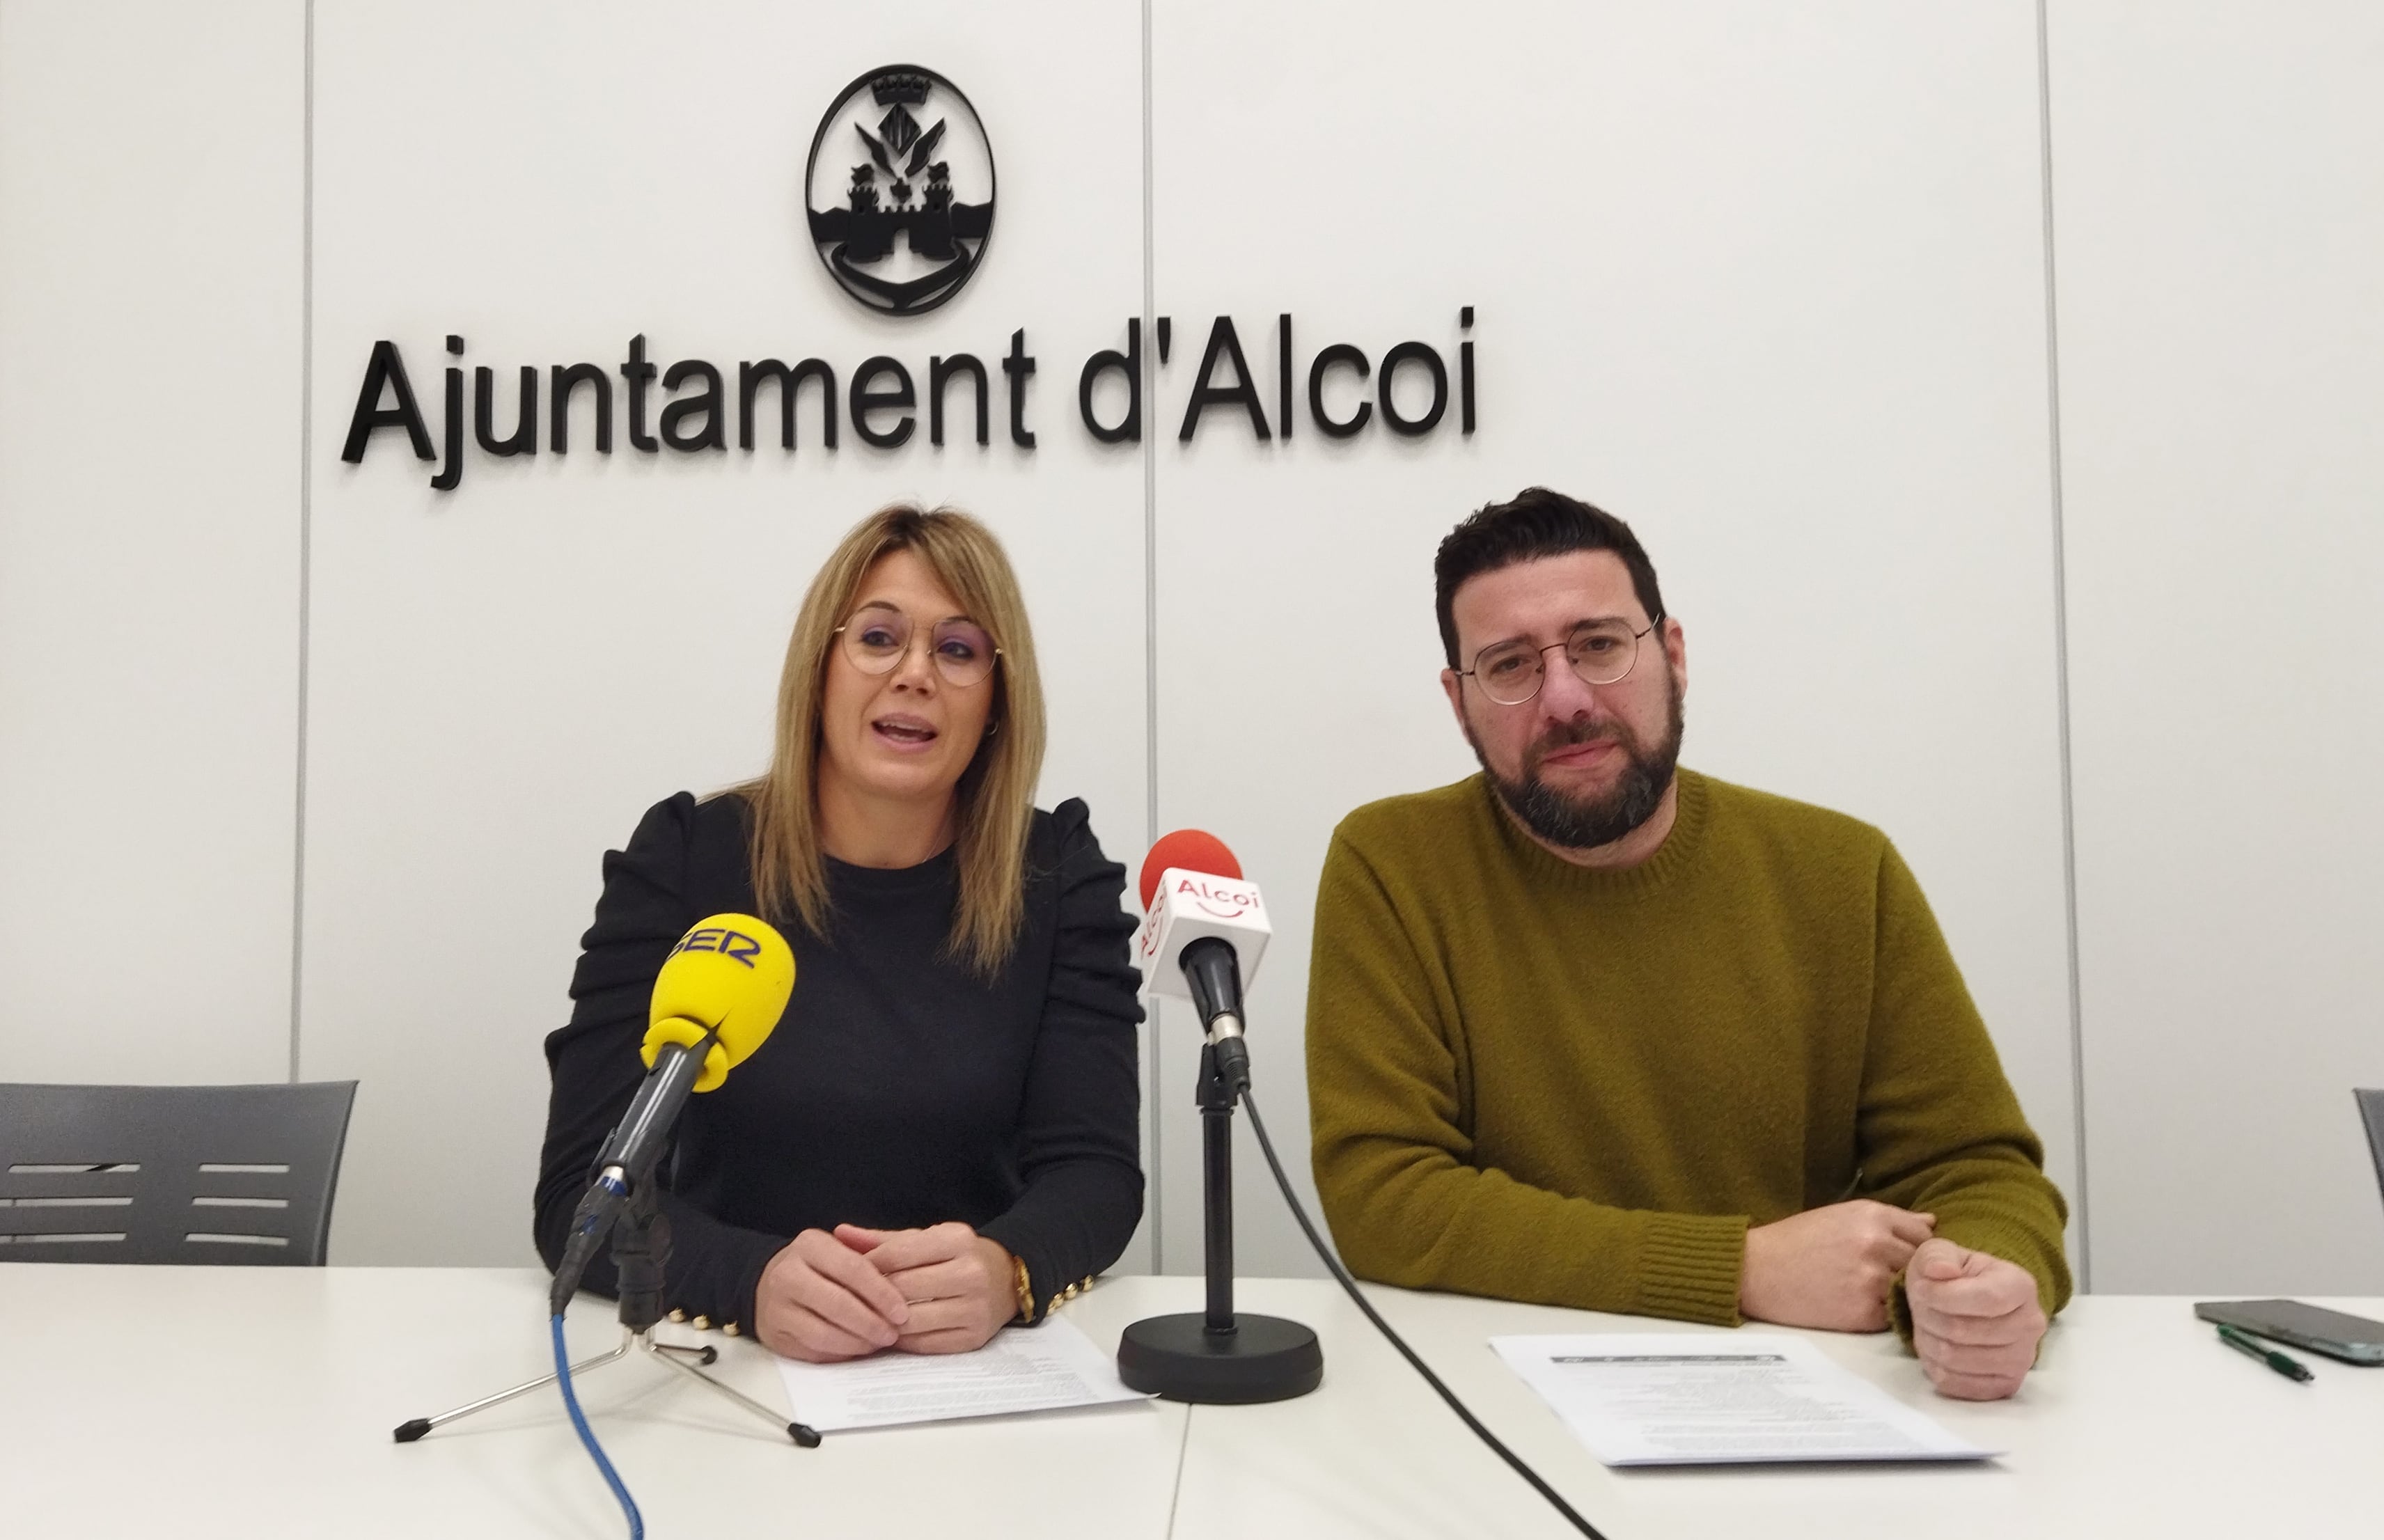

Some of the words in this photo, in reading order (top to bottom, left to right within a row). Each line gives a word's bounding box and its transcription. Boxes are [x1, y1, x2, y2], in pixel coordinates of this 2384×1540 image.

[340, 328, 1037, 492] Ajuntament
[1079, 306, 1477, 446] d'Alcoi
[1177, 879, 1259, 909] Alcoi
